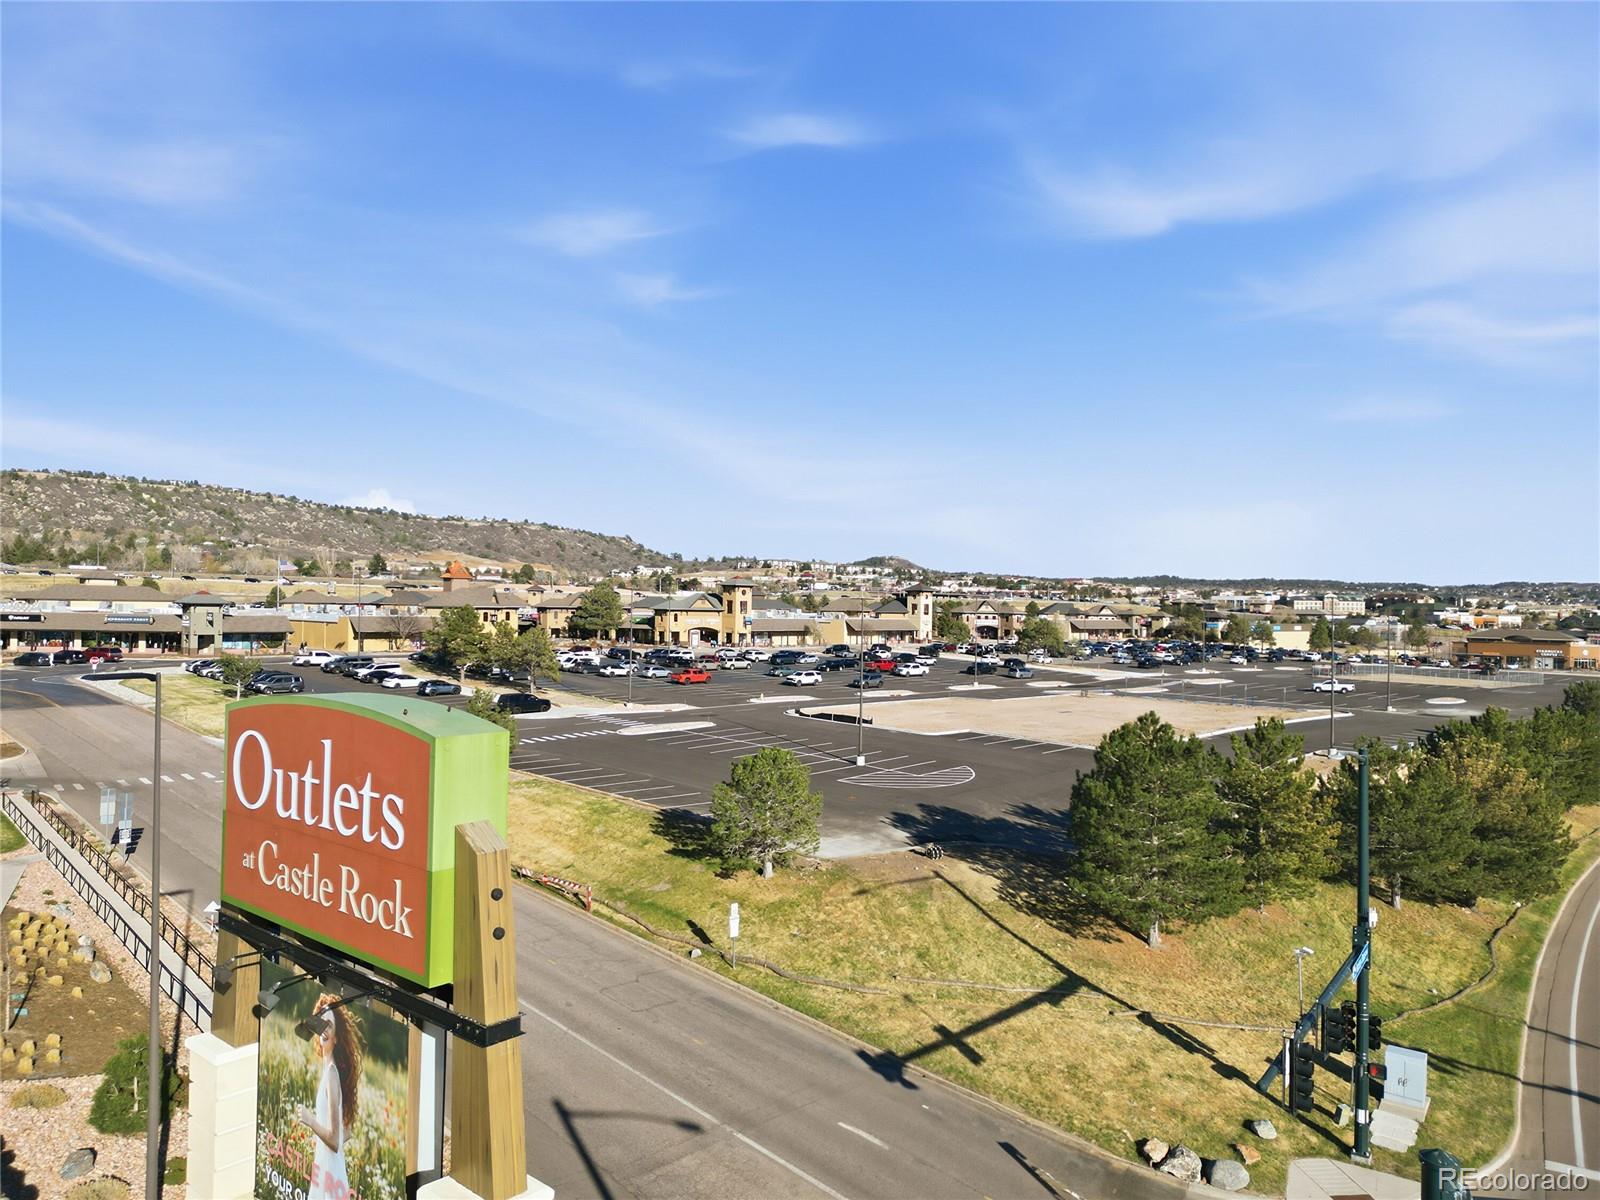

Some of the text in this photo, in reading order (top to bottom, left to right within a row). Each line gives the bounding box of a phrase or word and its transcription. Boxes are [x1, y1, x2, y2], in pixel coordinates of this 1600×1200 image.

[232, 729, 405, 850] Outlets
[242, 840, 414, 939] at Castle Rock
[265, 1166, 293, 1200] YOUR
[266, 1132, 320, 1188] CASTLE
